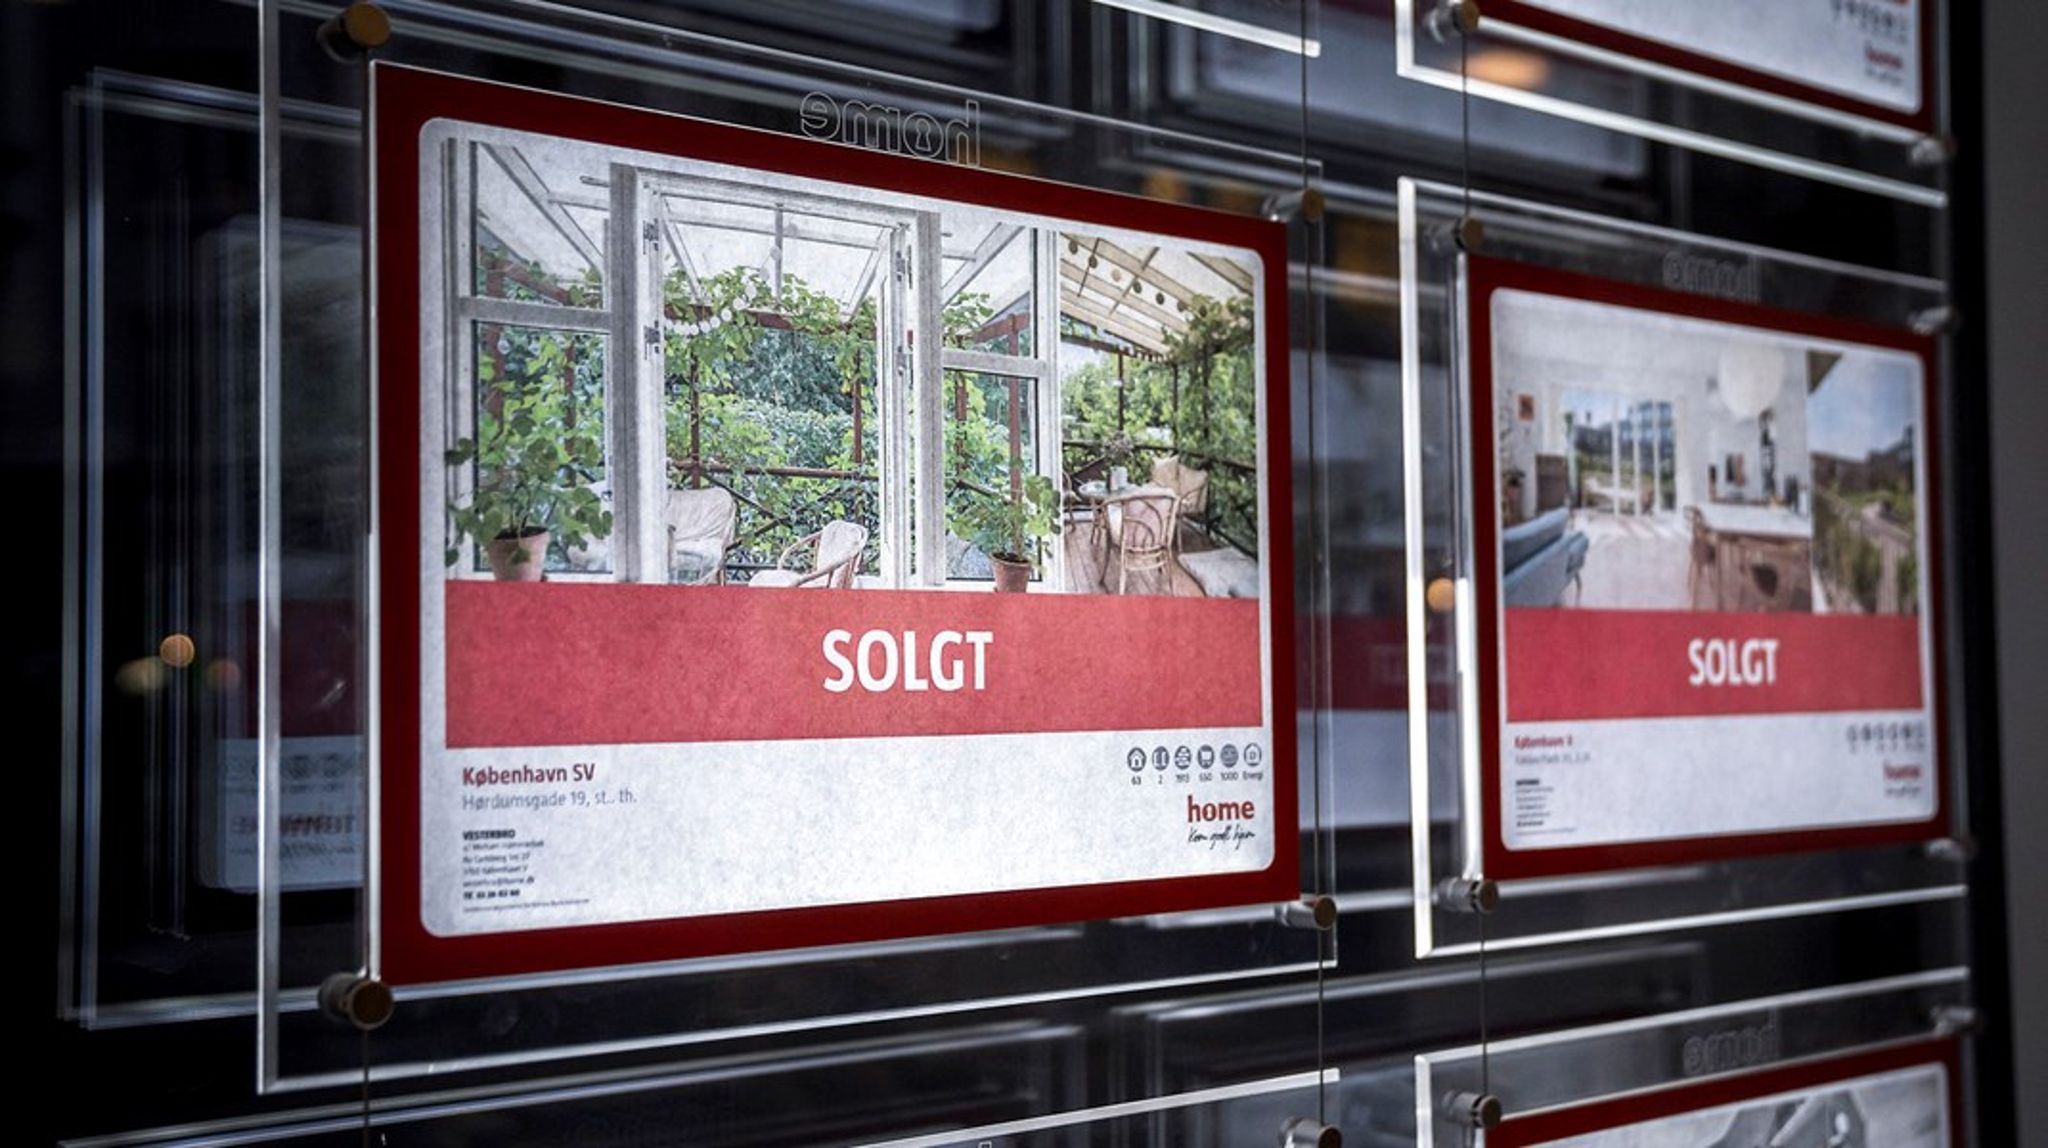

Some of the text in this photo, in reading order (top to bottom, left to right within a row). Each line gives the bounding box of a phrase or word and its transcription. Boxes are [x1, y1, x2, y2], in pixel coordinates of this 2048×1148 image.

[822, 628, 994, 692] SOLGT
[1687, 637, 1779, 686] SOLGT
[462, 762, 596, 788] København SV
[462, 791, 567, 812] Hørdumsgade
[570, 790, 591, 808] 19,
[618, 788, 638, 804] th.
[1187, 794, 1256, 823] home
